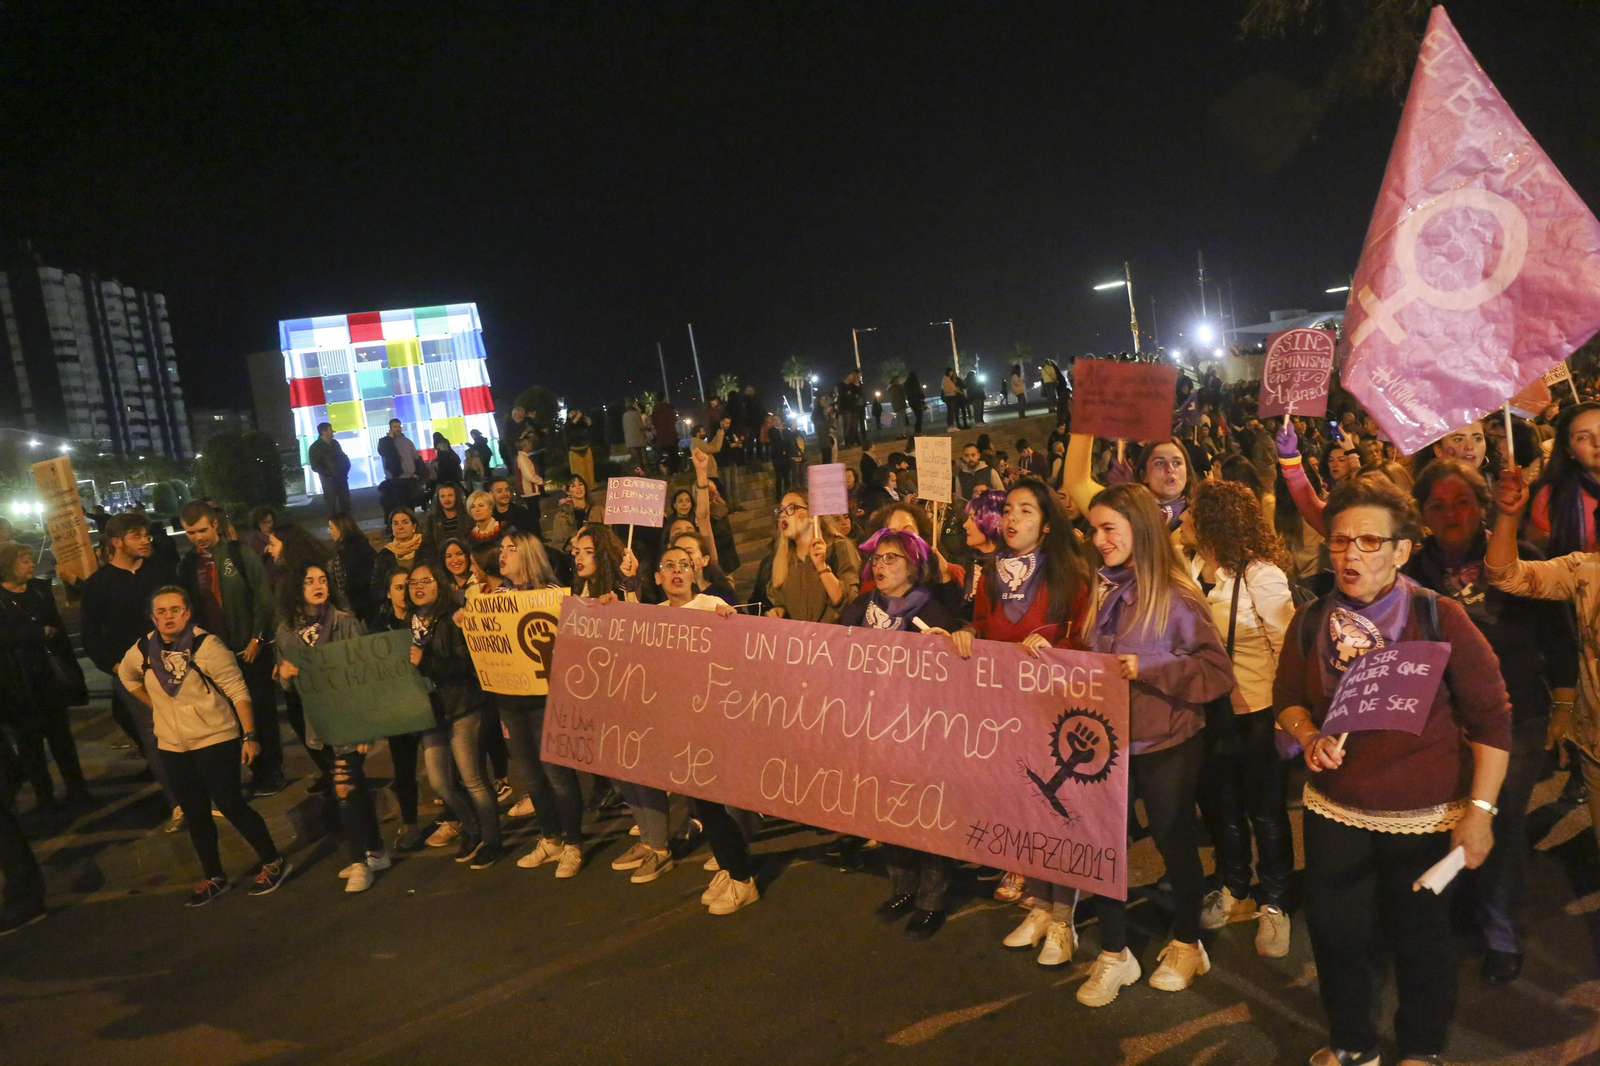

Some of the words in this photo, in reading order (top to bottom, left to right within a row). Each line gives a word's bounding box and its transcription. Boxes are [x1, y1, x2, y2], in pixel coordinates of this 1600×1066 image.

[1274, 333, 1330, 353] SIN
[1269, 355, 1331, 373] FEMINISMO
[609, 492, 620, 501] AL
[622, 489, 661, 501] FEMINISMO
[474, 595, 519, 614] QUITARON
[463, 616, 479, 632] QUE
[481, 616, 502, 632] NOS
[345, 634, 394, 666] NO
[466, 634, 513, 655] QUITARON
[608, 618, 627, 641] DE
[630, 620, 712, 653] MUJERES
[745, 632, 777, 661] UN
[786, 632, 834, 667] DÍA
[847, 642, 949, 682] DESPUÉS
[976, 656, 1003, 689] EL
[1018, 660, 1104, 701] BORGE
[1357, 657, 1367, 671] A
[1369, 649, 1399, 666] SER
[479, 669, 492, 687] EL
[1345, 665, 1390, 687] MUJER
[1397, 661, 1431, 676] QUE
[1340, 687, 1358, 702] DE
[1362, 682, 1379, 695] LA
[565, 646, 658, 704] Sin
[691, 662, 1022, 760] Feminismo
[1358, 698, 1380, 713] DE
[1386, 694, 1419, 714] SER
[545, 730, 595, 765] MENOS
[598, 722, 654, 769] no
[669, 742, 718, 787] se
[760, 757, 956, 831] avanza
[965, 819, 1117, 884] #8MARZO2019
